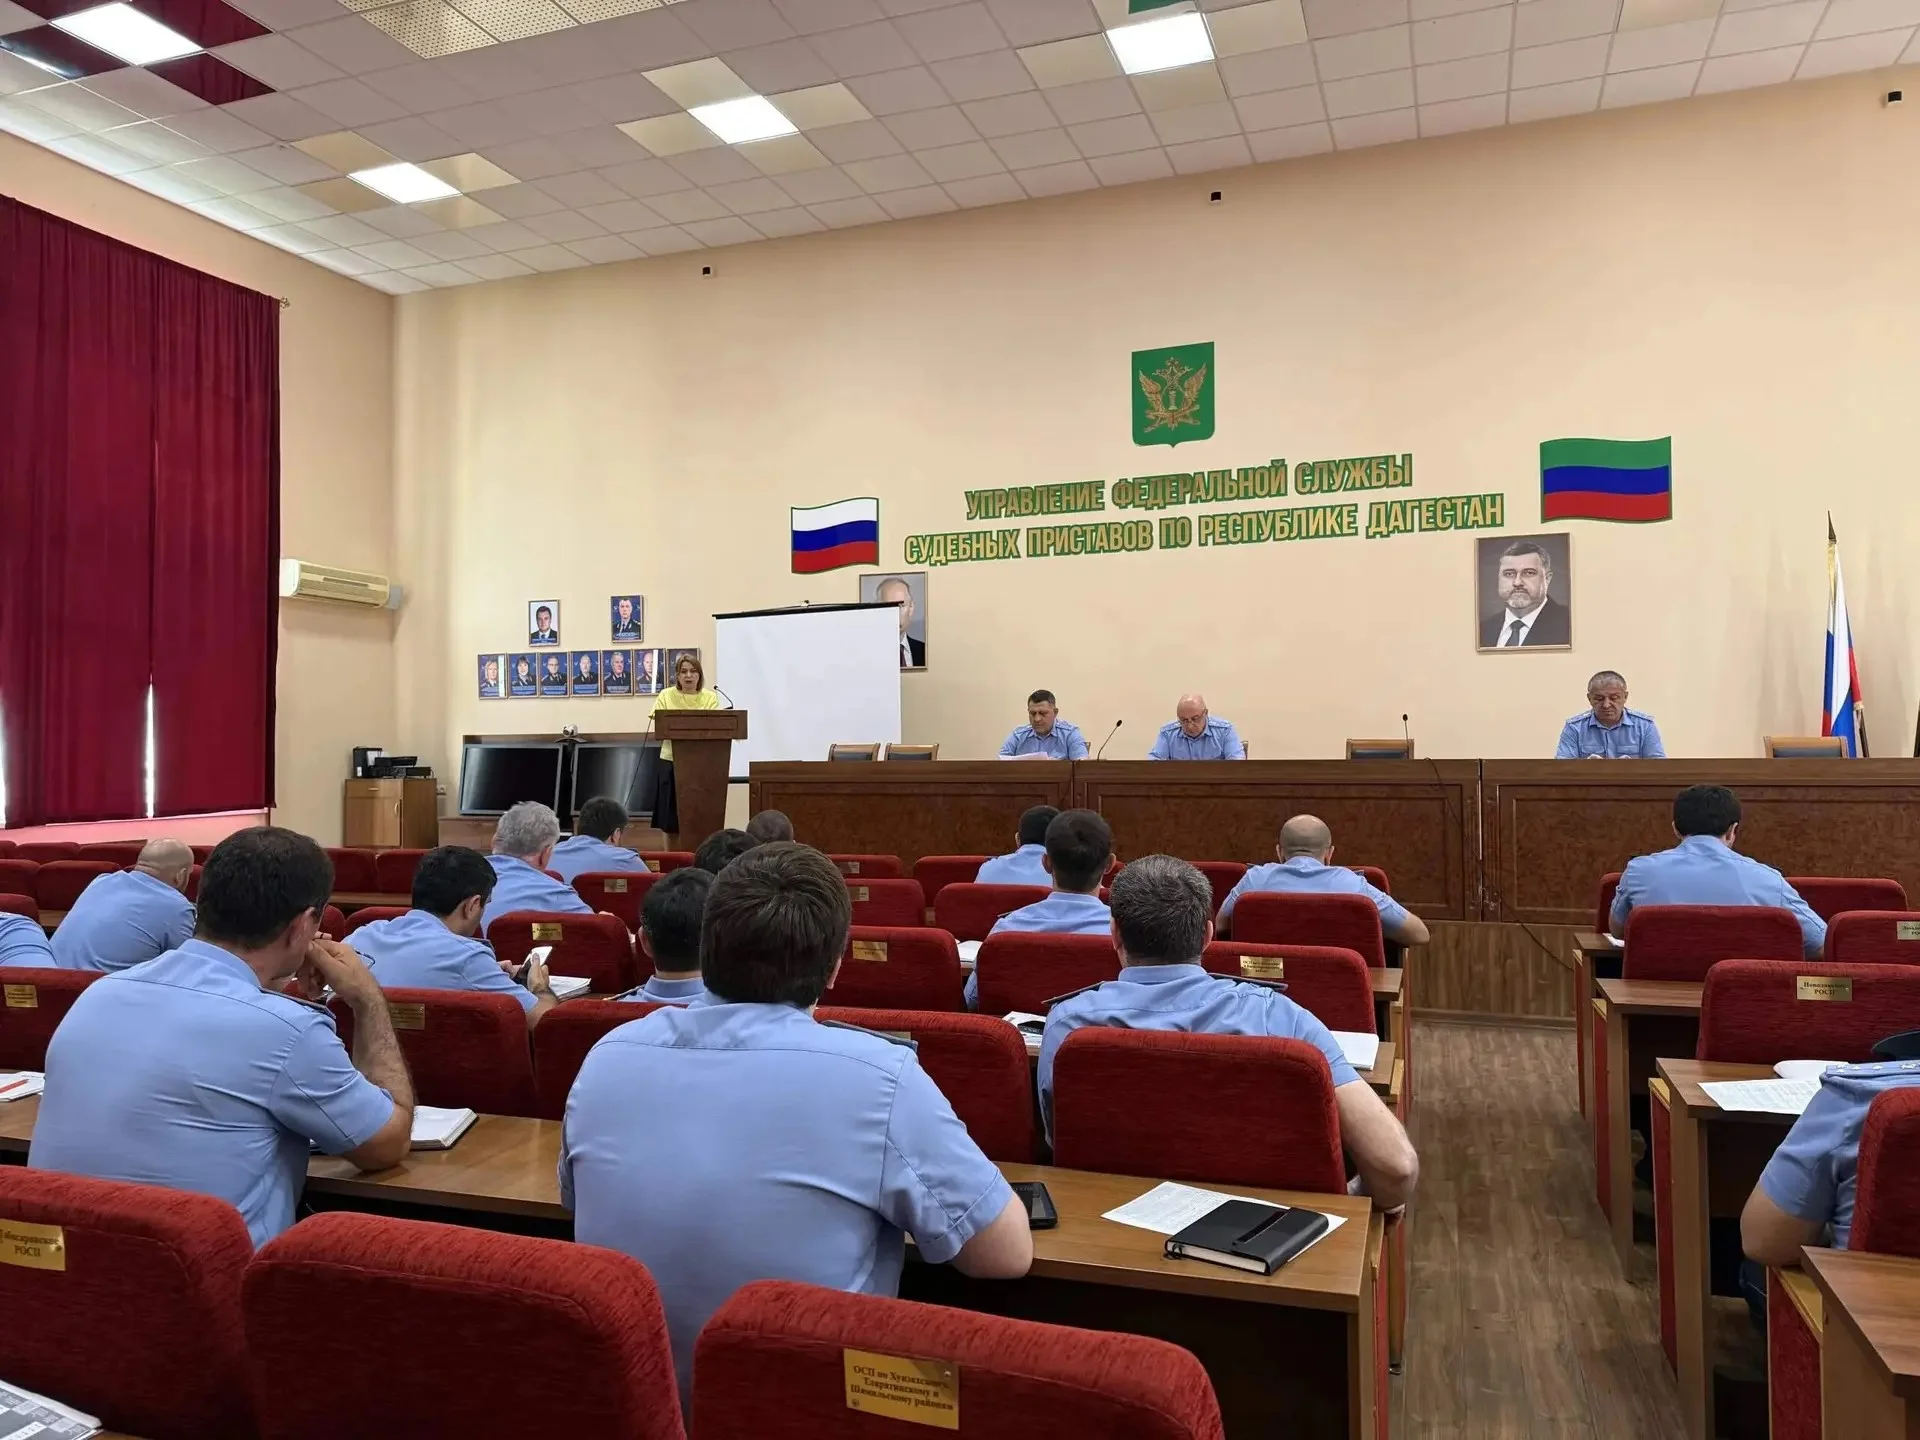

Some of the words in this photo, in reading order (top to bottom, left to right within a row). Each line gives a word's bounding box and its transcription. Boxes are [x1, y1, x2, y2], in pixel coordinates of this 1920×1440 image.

[964, 480, 1105, 520] УПРАВЛЕНИЕ
[1111, 458, 1288, 510] ФЕДЕРАЛЬНОЙ
[1294, 453, 1413, 494] СЛУЖБЫ
[904, 528, 1021, 566] СУДЕБНЫХ
[1026, 520, 1154, 558] ПРИСТАВОВ
[1159, 516, 1193, 549] ПО
[1198, 503, 1359, 546] РЕСПУБЛИКЕ
[1365, 493, 1504, 539] ДАГЕСТАН
[853, 1365, 876, 1377] ОСП
